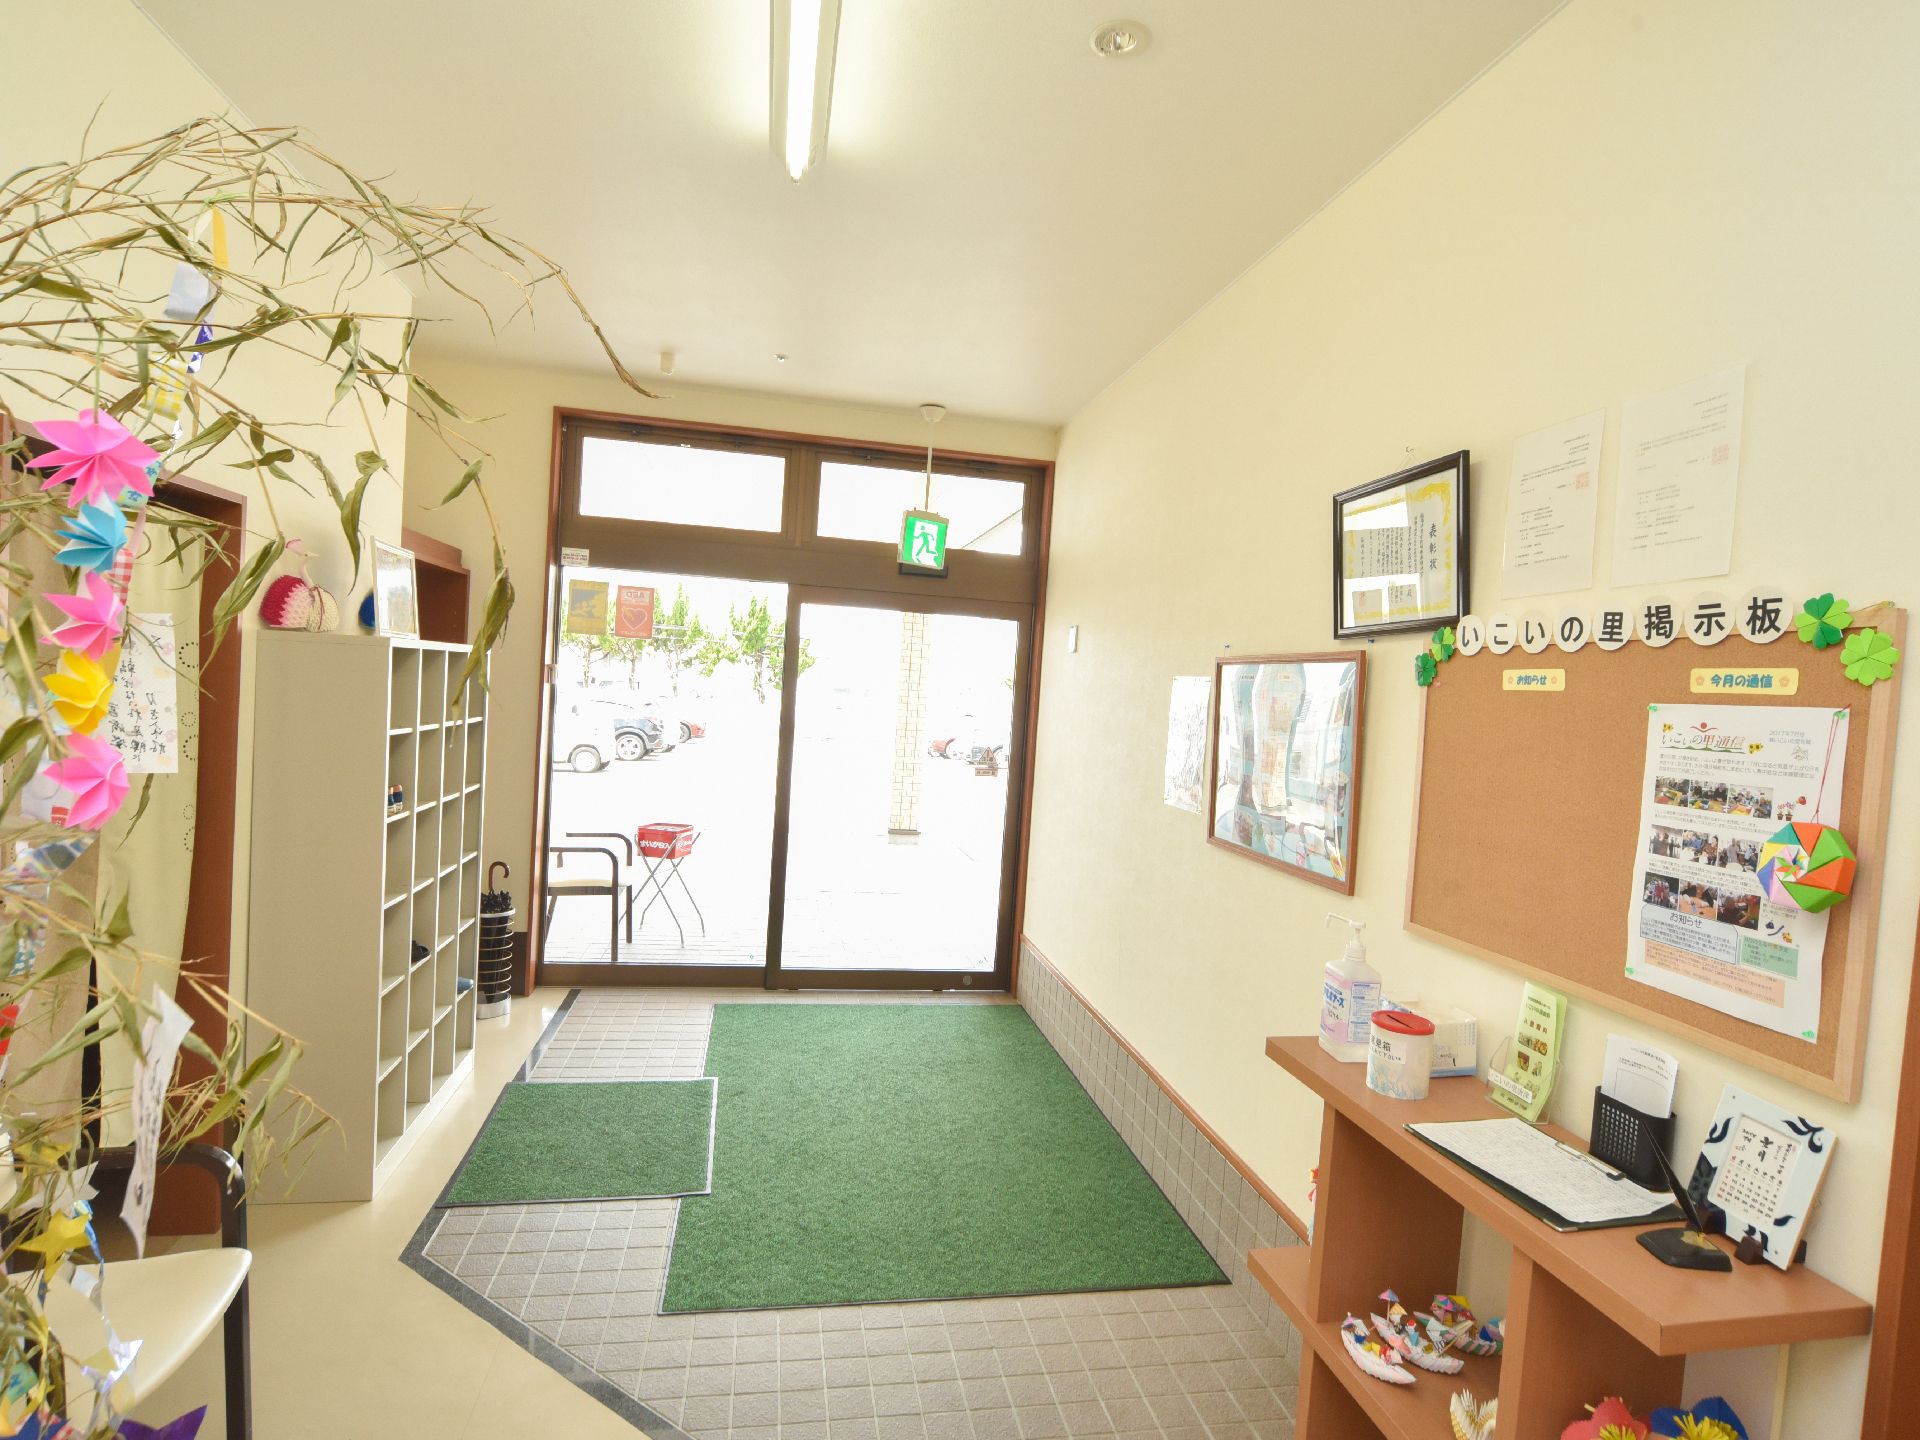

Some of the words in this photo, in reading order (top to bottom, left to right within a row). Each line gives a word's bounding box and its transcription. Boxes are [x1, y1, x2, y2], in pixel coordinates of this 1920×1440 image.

[1461, 596, 1783, 647] いこいの里掲示板
[1516, 674, 1548, 687] お知らせ
[1710, 673, 1774, 689] 今月の通信
[1670, 911, 1702, 928] お知らせ
